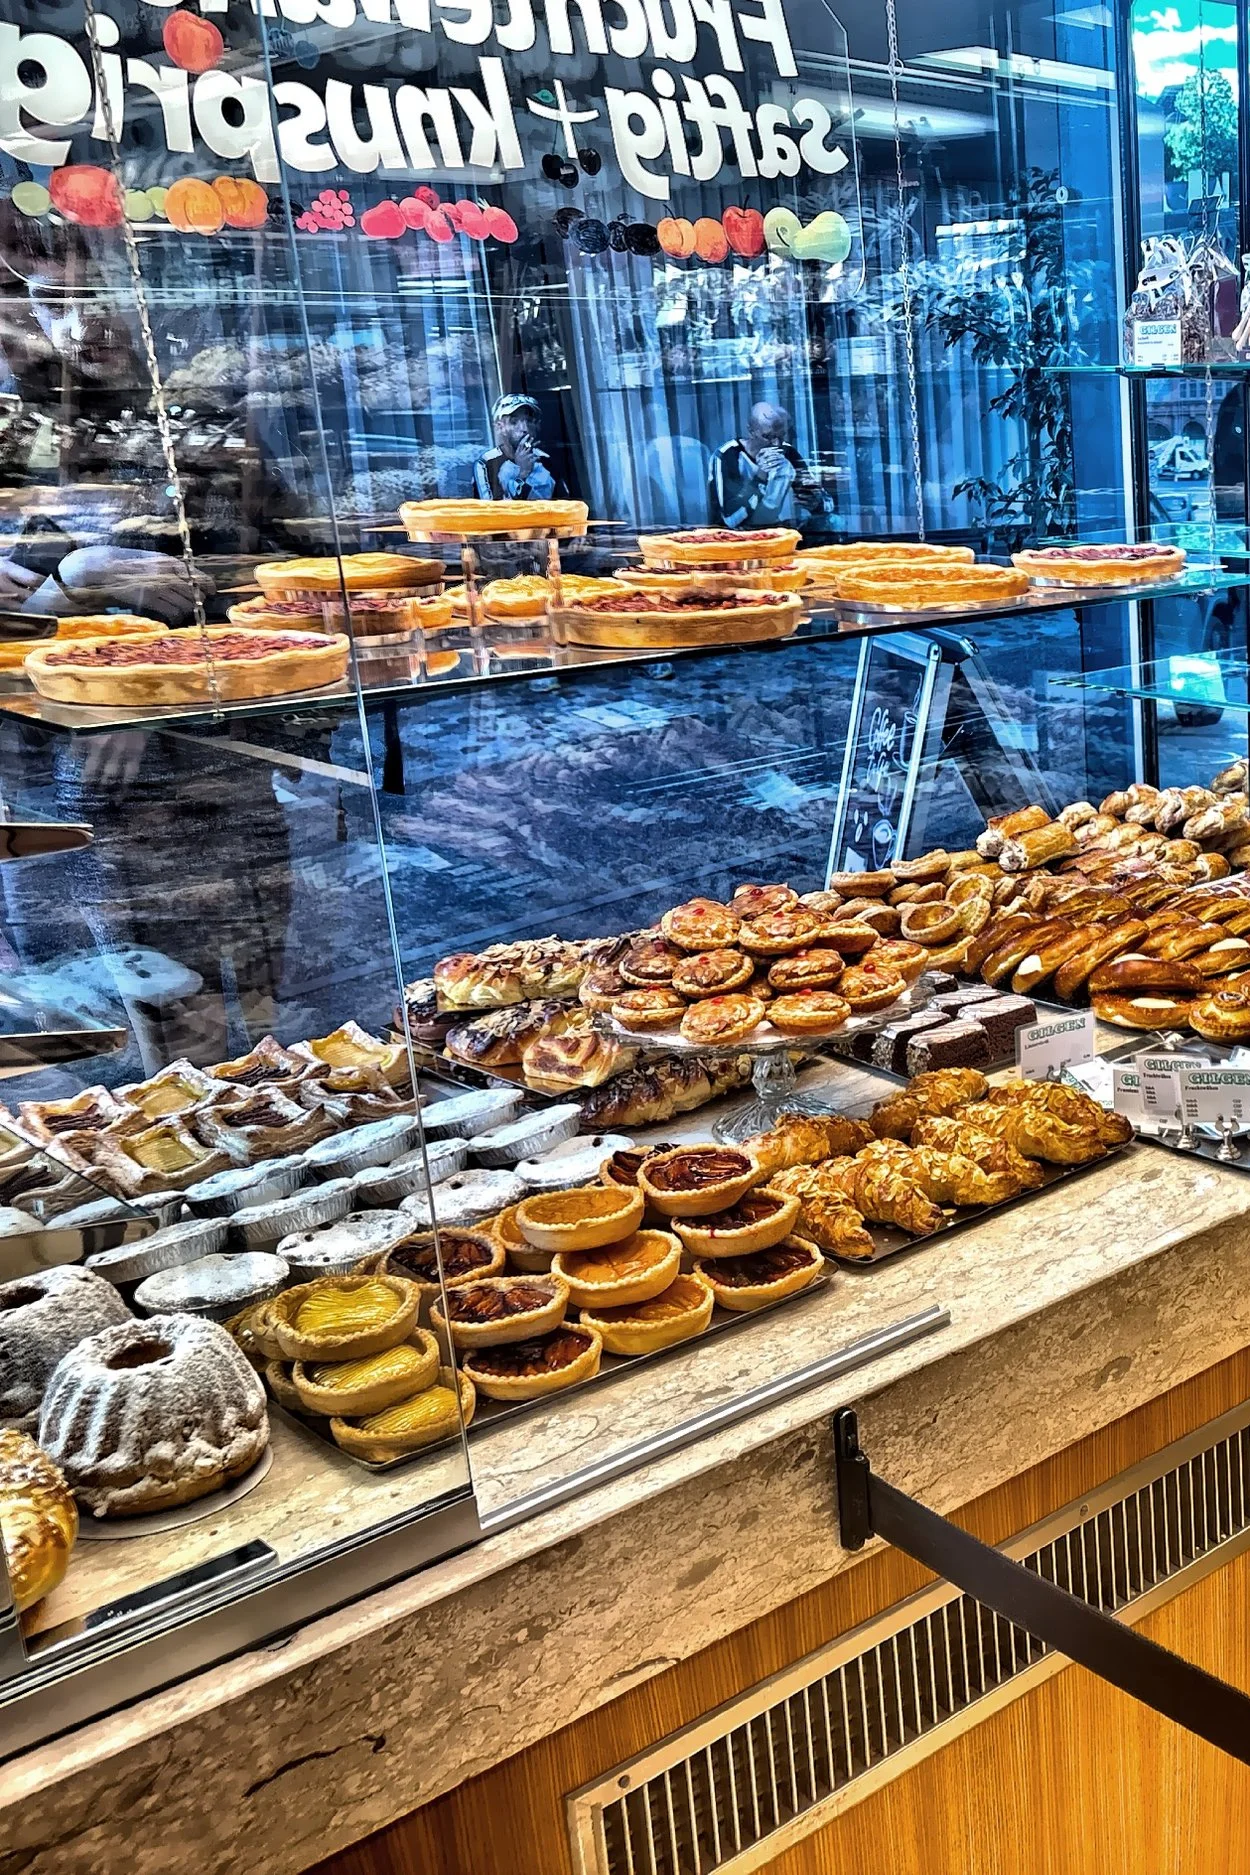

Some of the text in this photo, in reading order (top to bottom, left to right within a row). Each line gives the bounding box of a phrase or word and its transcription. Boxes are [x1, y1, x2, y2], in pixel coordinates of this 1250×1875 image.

[1140, 324, 1177, 335] GILGEN
[1027, 1018, 1086, 1041] GILGEN
[1144, 1058, 1202, 1073] GILGEN
